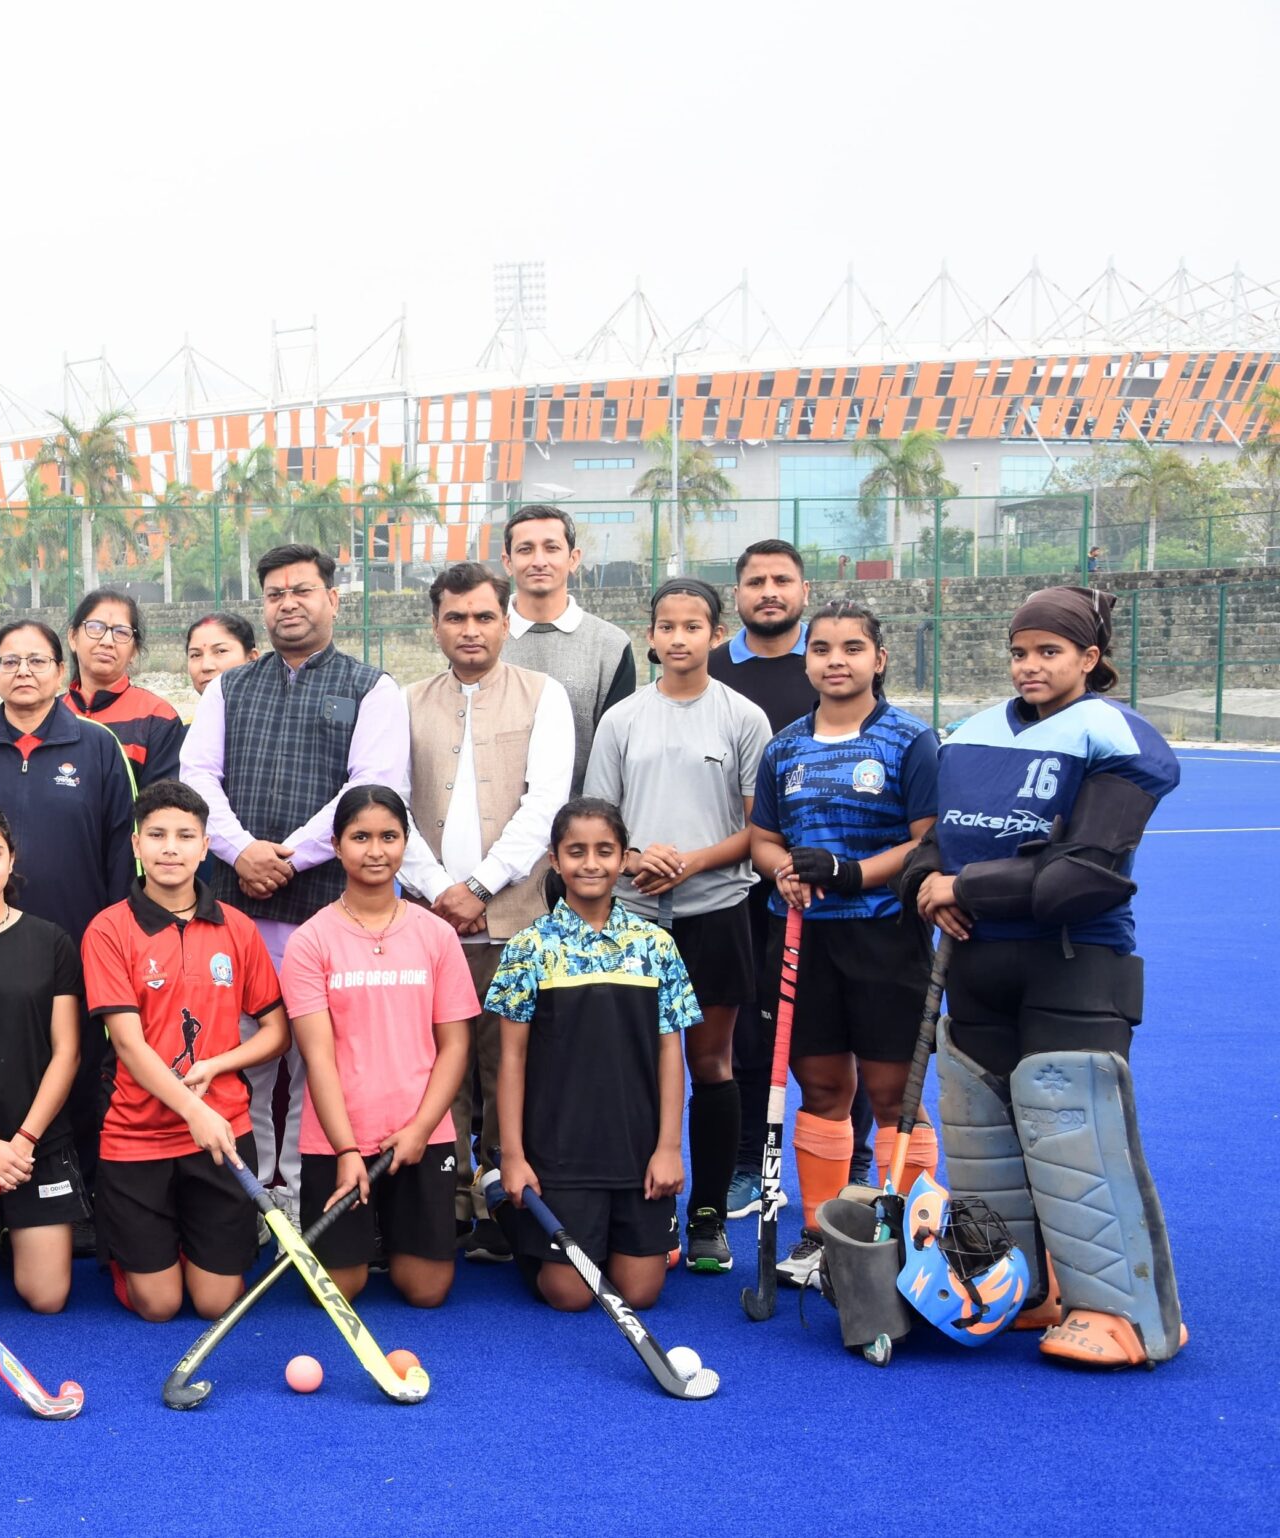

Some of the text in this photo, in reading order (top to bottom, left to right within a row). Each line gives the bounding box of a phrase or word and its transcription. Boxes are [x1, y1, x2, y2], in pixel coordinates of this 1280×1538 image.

[1017, 757, 1060, 800] 16
[345, 971, 365, 987] BIG
[400, 969, 427, 985] HOME
[294, 1248, 363, 1341] ALFA
[601, 1293, 647, 1344] ALFA
